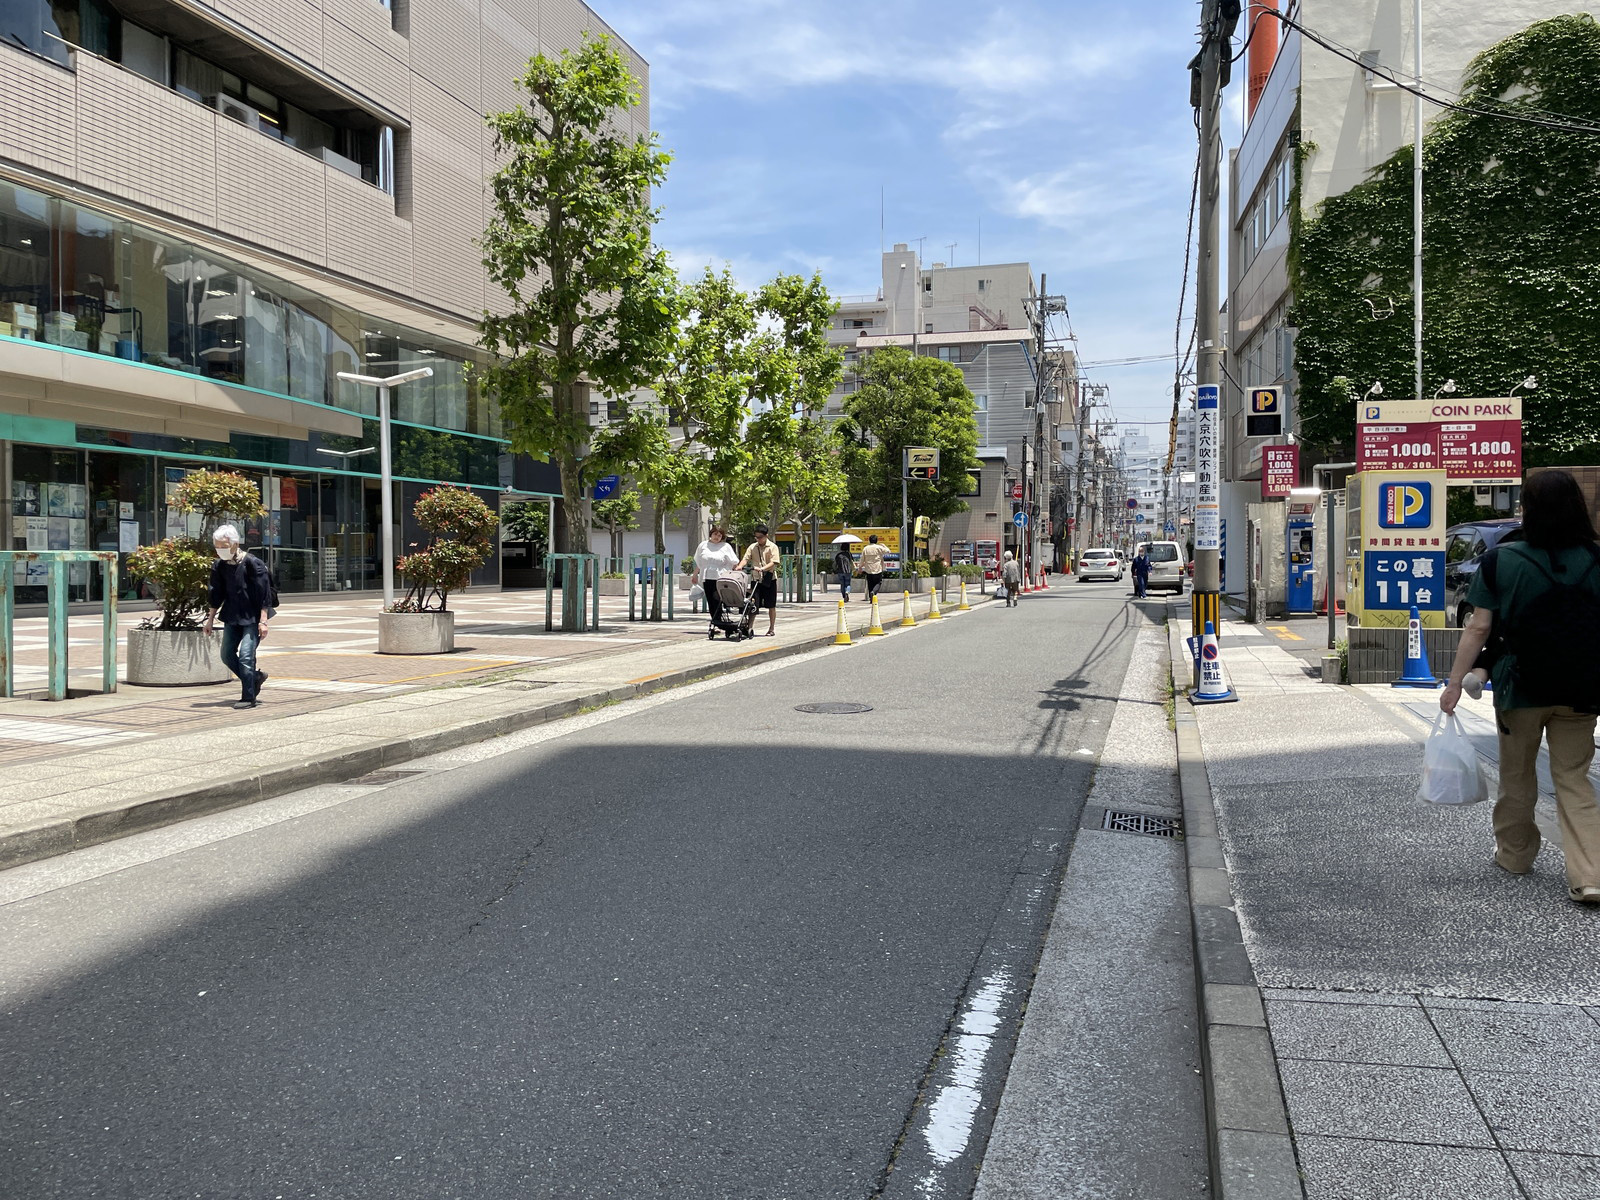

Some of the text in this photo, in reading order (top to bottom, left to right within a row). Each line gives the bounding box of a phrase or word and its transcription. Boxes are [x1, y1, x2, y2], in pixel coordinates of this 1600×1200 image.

[1432, 405, 1469, 416] COIN
[1474, 404, 1513, 416] PARK
[1199, 412, 1210, 494] 大京穴吹不動産
[928, 468, 936, 478] P
[1370, 538, 1440, 546] 時間貸駐車場
[1377, 558, 1434, 578] この裏
[1376, 581, 1432, 603] 11台
[1203, 662, 1220, 670] 駐車
[1204, 672, 1221, 680] 禁止
